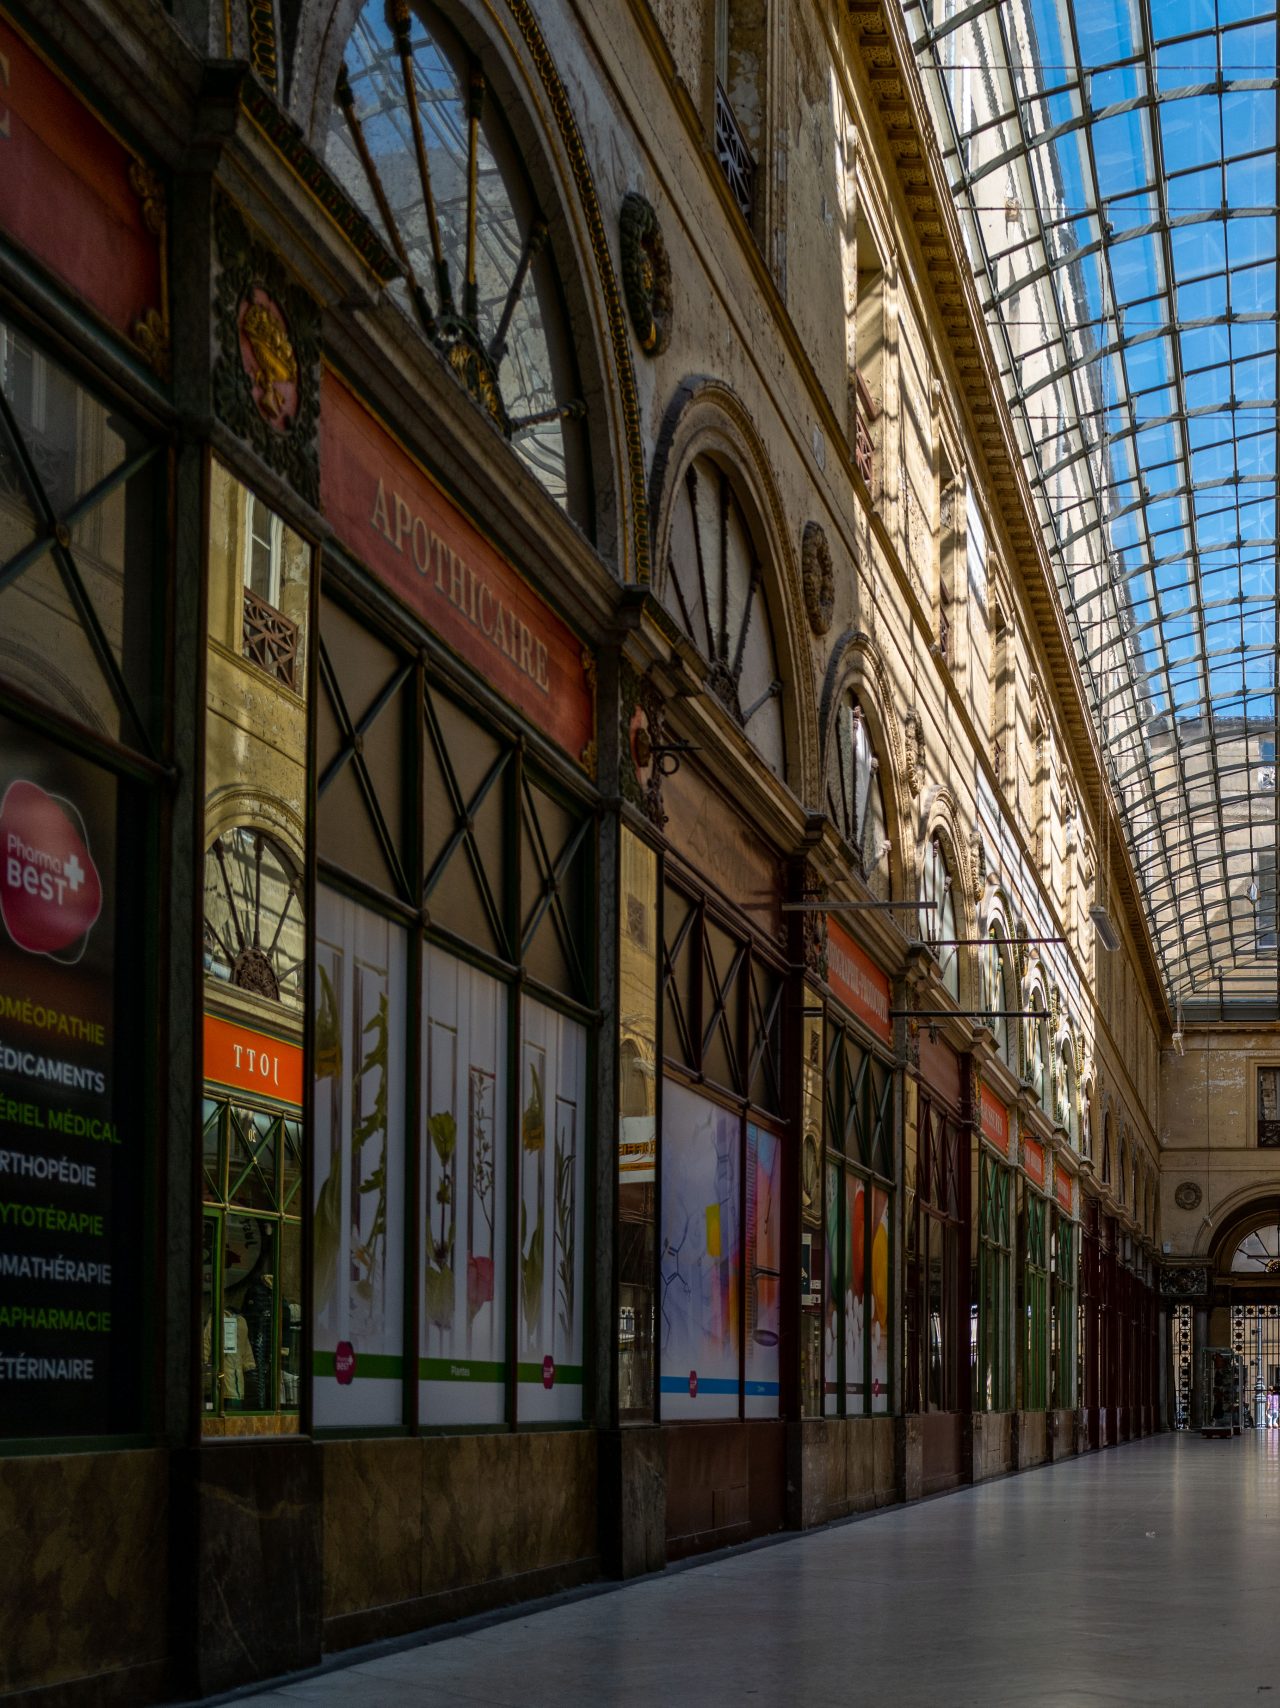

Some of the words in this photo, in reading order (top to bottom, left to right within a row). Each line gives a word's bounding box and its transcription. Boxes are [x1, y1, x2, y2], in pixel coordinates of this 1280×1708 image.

[371, 477, 549, 694] APOTHICAIRE
[8, 833, 62, 873] Pharma
[49, 1106, 123, 1145] MÉDICAL
[0, 1254, 112, 1286] MATHÉRAPIE
